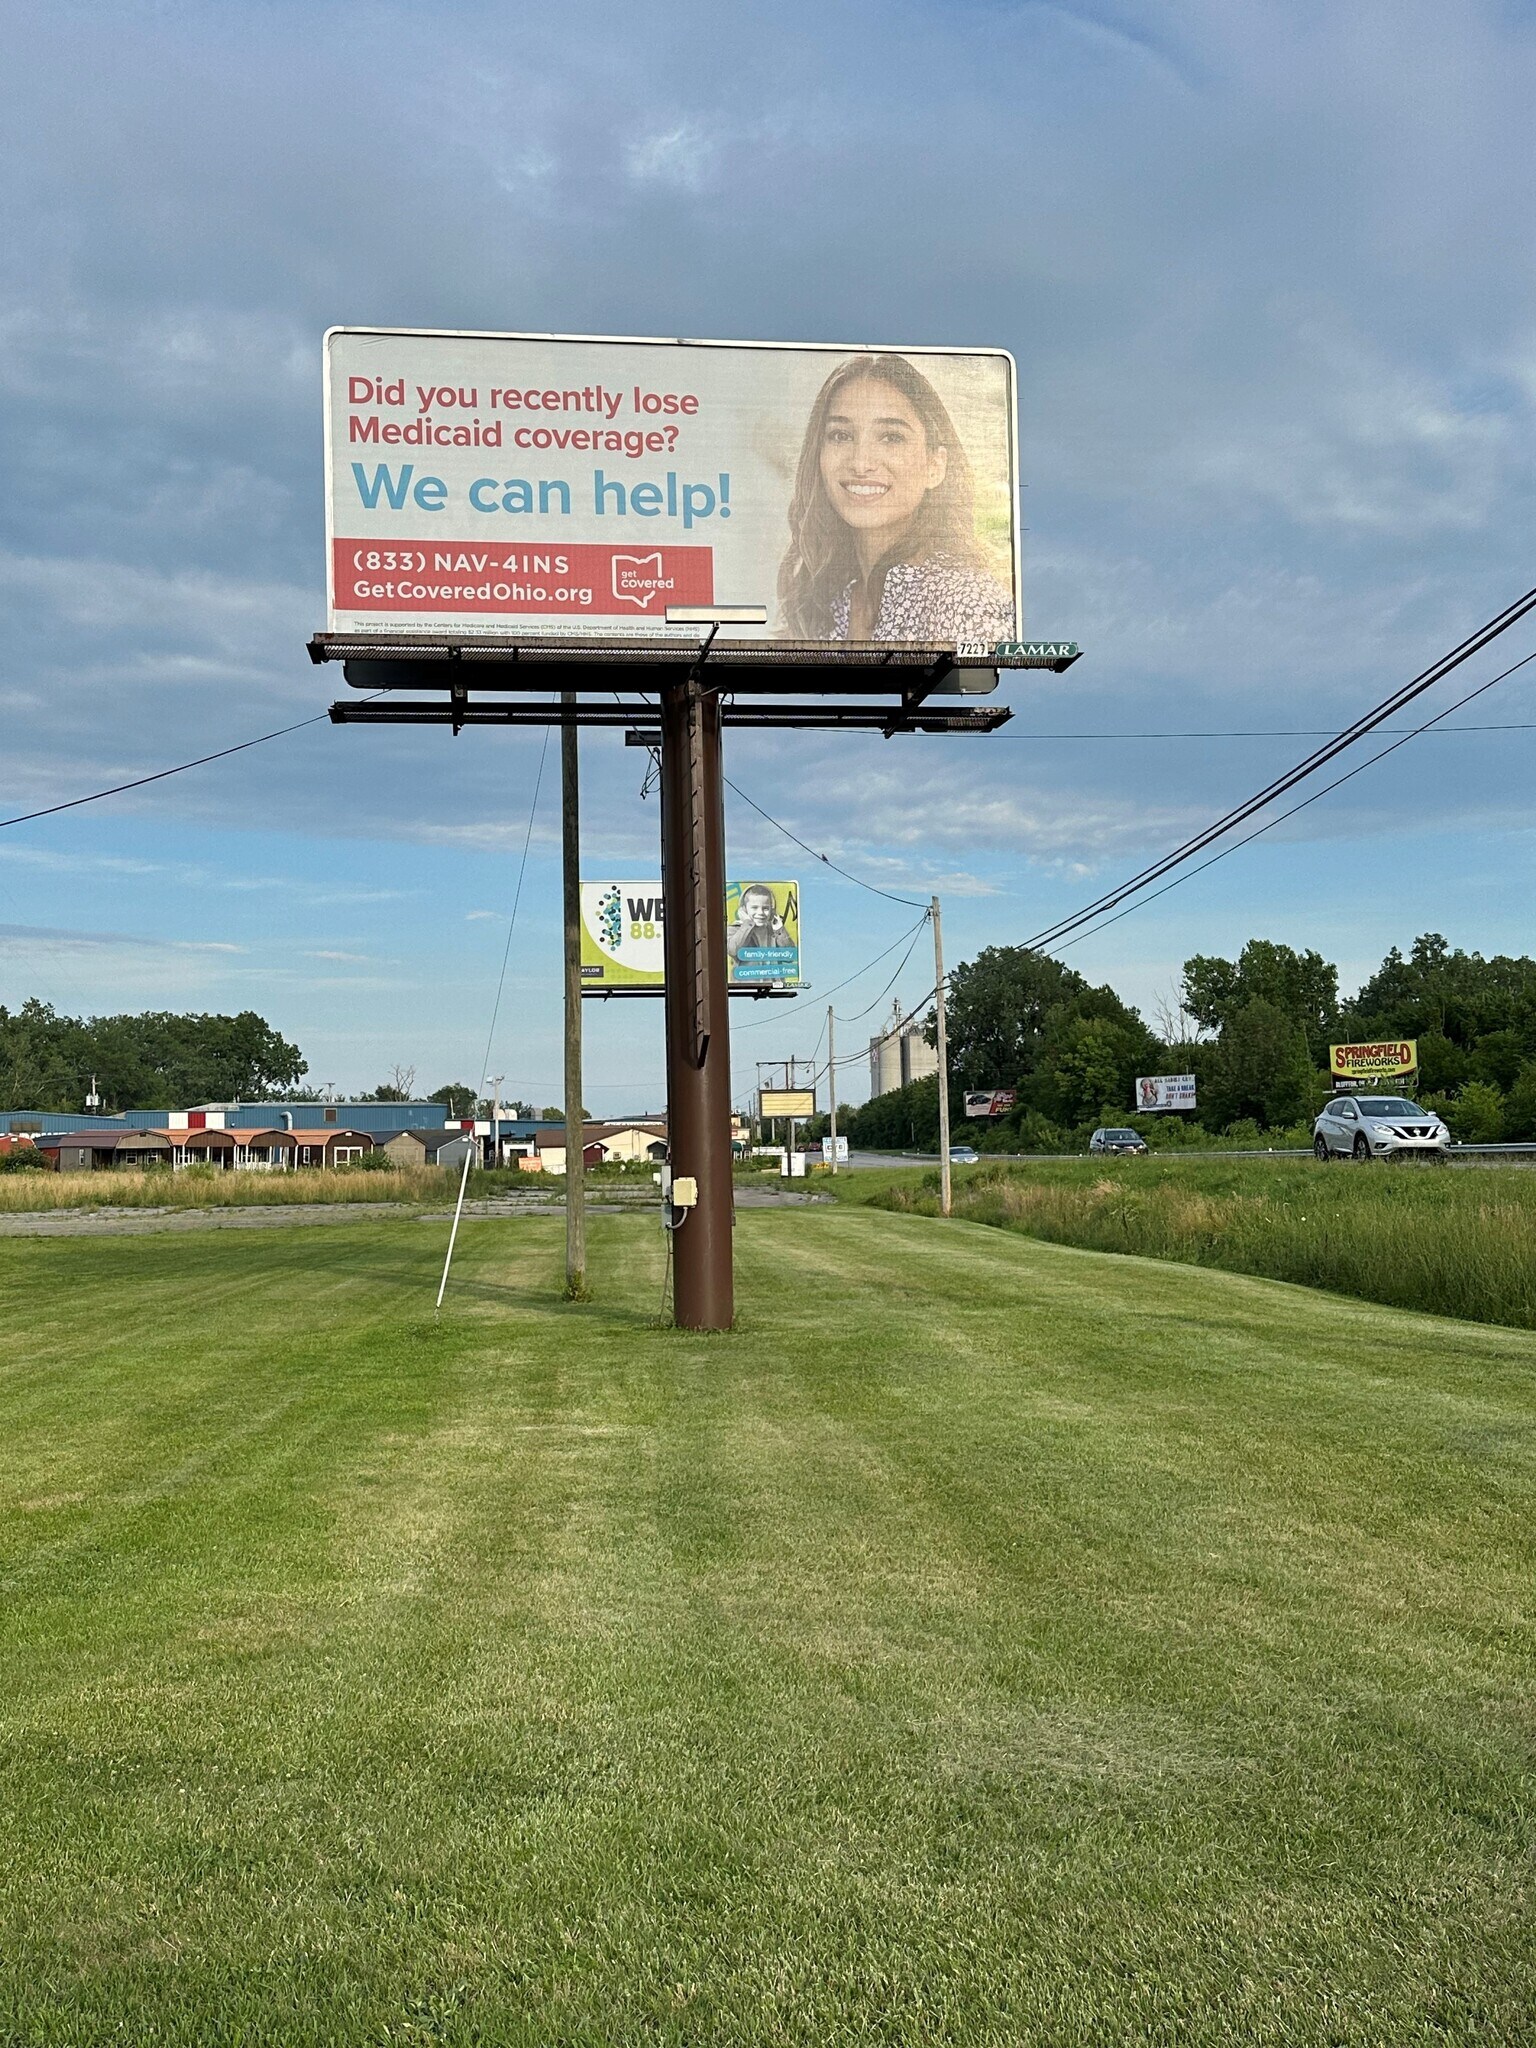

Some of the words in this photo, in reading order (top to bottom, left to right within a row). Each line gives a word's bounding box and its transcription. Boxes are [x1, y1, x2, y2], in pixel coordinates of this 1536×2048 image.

[348, 376, 406, 406] Did
[416, 385, 478, 413] you
[491, 385, 623, 419] recently
[634, 386, 699, 415] lose
[349, 416, 502, 448] Medicaid
[514, 425, 679, 459] coverage?
[351, 462, 448, 512] We
[468, 477, 571, 515] can
[594, 470, 731, 529] help!
[353, 550, 426, 573] (833)
[434, 553, 569, 575] NAV-4INS
[621, 569, 637, 580] get
[620, 576, 674, 590] covered
[353, 581, 593, 605] GetCoveredOhio.org
[960, 642, 986, 654] 7227
[1004, 644, 1070, 656] LAMAR
[630, 922, 662, 940] 88.
[744, 950, 794, 959] family-friendly
[738, 966, 796, 977] commercial-free
[1336, 1044, 1411, 1068] SPRINGFIELD
[1346, 1057, 1400, 1068] FIREWORKS
